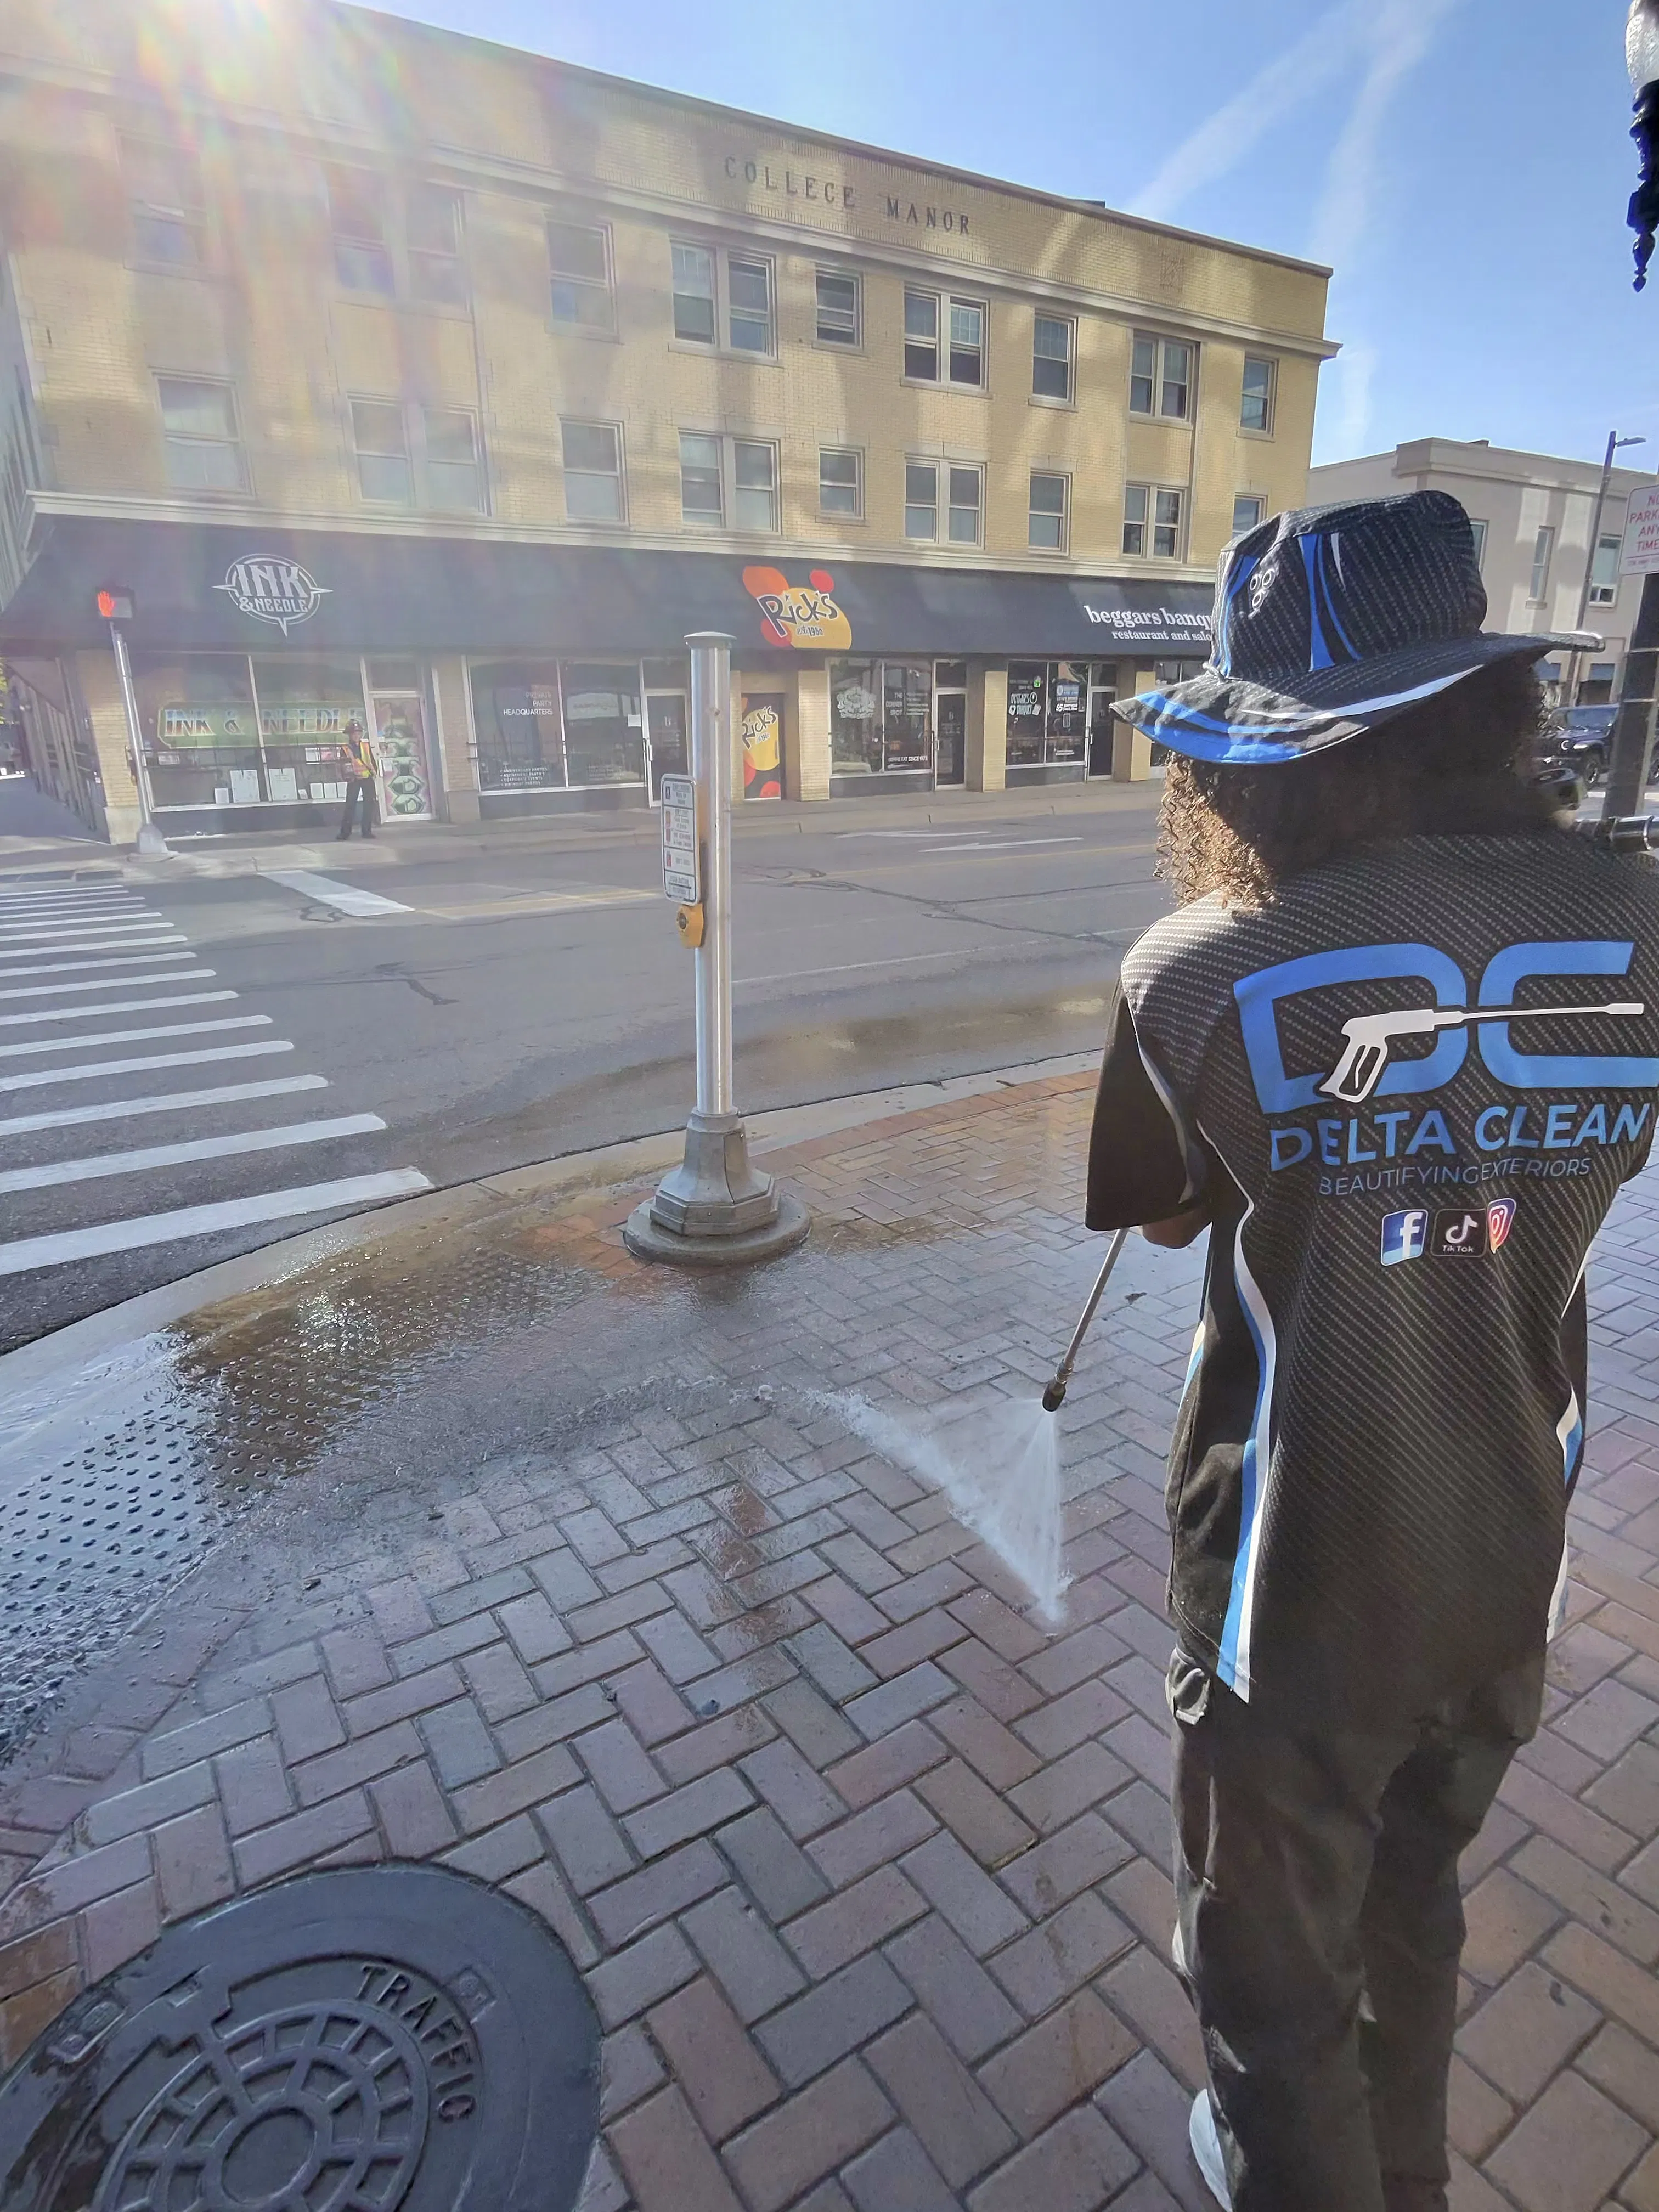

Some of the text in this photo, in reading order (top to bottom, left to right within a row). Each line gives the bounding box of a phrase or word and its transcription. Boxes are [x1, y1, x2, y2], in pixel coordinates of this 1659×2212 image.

[887, 194, 969, 235] MANOR
[1629, 509, 1659, 524] PARK
[235, 564, 308, 597] INK
[1084, 605, 1212, 630] beggars banq
[1111, 630, 1212, 641] restaurant and salo
[164, 709, 216, 736] INK
[1233, 941, 1659, 1115] DC
[1270, 1103, 1651, 1172] DELTA CLEAN
[356, 1963, 477, 2123] TRAFFIC
